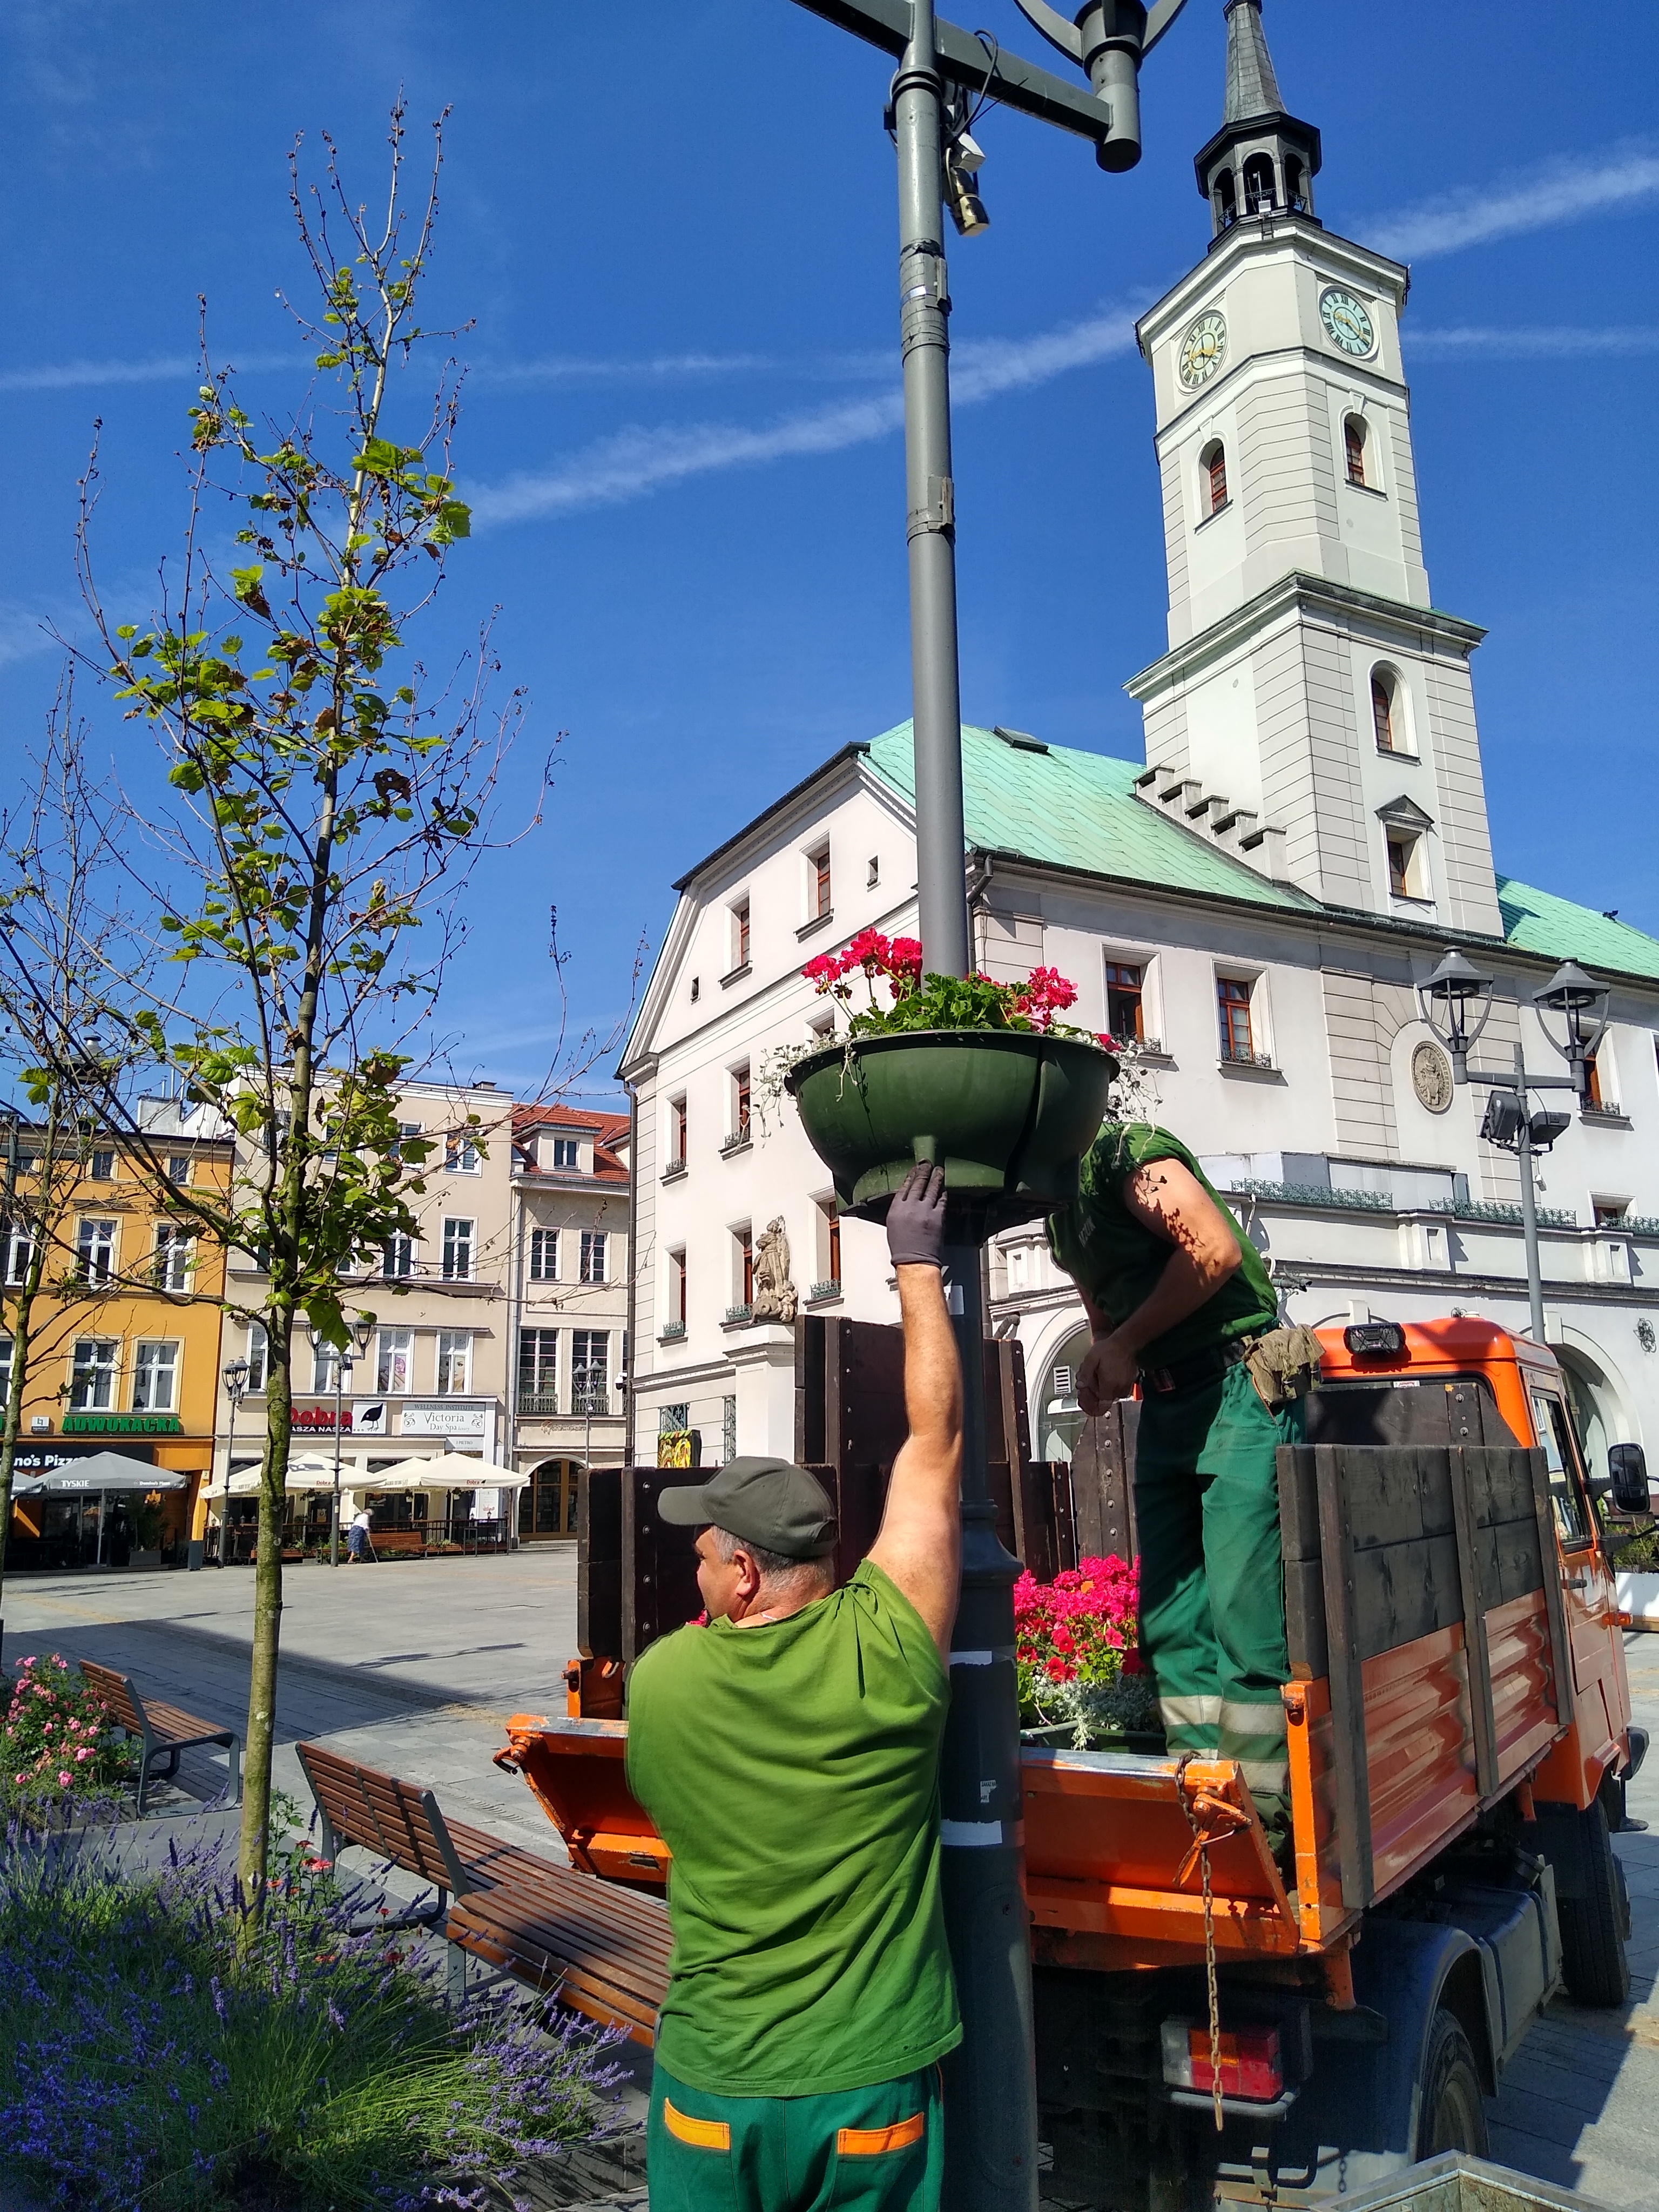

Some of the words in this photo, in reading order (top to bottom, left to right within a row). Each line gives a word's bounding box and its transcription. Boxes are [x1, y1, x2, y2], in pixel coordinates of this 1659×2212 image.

[291, 1407, 353, 1425] Dobra
[424, 1412, 464, 1424] Victoria
[62, 1417, 180, 1432] ADWOKACKA
[430, 1423, 443, 1432] Day
[445, 1423, 457, 1432] Spa
[14, 1454, 41, 1466] no's
[44, 1454, 78, 1466] Pizz
